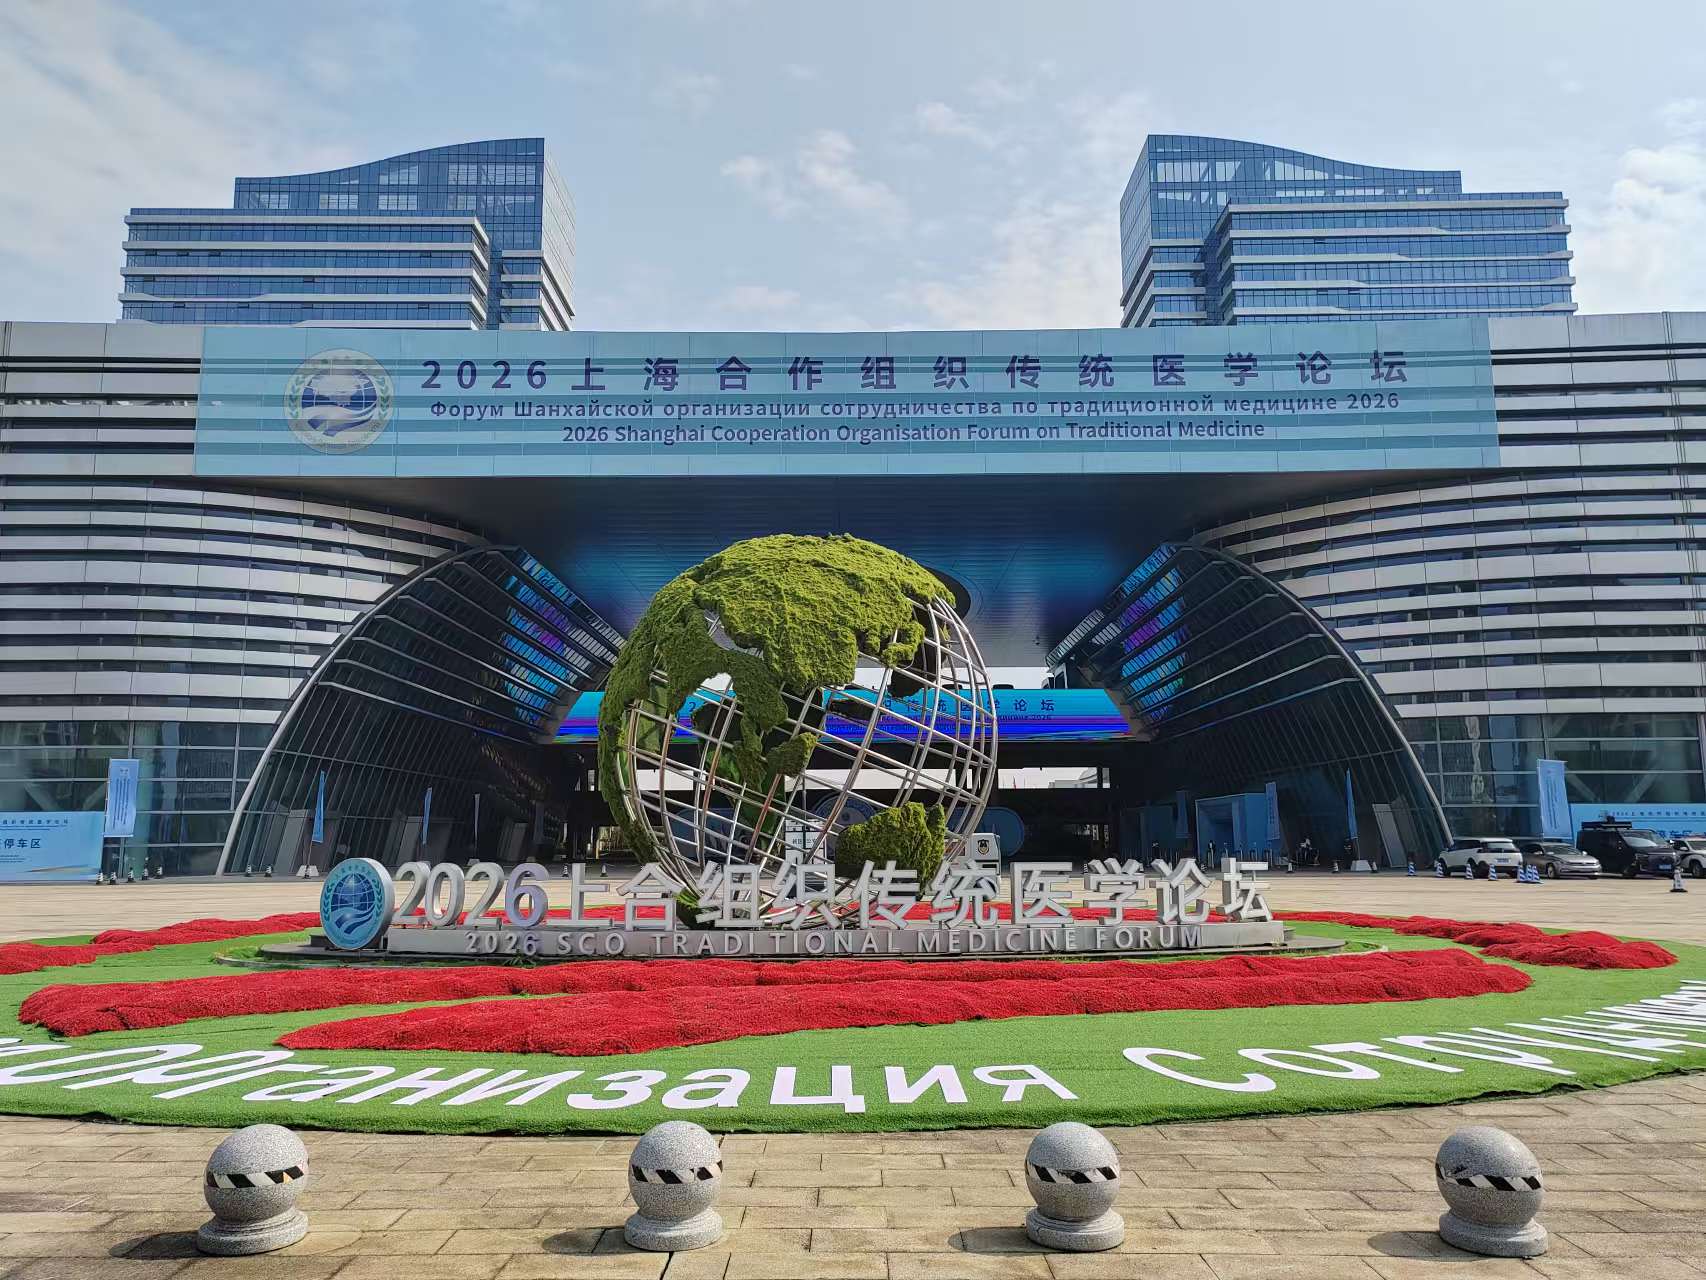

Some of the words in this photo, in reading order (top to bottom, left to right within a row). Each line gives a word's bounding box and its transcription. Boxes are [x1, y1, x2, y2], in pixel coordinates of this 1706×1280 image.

[421, 350, 1407, 391] 2026上海合作组织传统医学论坛
[430, 401, 504, 420] Форум
[514, 400, 653, 417] Шанхайской
[663, 402, 810, 419] организации
[820, 401, 1001, 419] сотрудничества
[1012, 401, 1038, 414] по
[1048, 394, 1214, 416] традиционной
[1224, 398, 1337, 414] медицине
[1347, 393, 1400, 409] 2026
[562, 425, 608, 442] 2026
[615, 424, 705, 445] Shanghai
[711, 424, 830, 445] Cooperation
[836, 424, 961, 445] Organisation
[967, 423, 1030, 441] Forum
[1037, 427, 1060, 439] on
[1066, 421, 1173, 439] Traditional
[1178, 420, 1265, 438] Medicine
[0, 837, 41, 849] 停车区
[393, 857, 1273, 931] 2026上合组织传统医学论坛
[465, 931, 541, 957] 2026
[558, 933, 626, 956] SCO
[653, 929, 900, 956] TRADITIONAL
[917, 928, 1078, 953] MEDICINE
[1096, 925, 1202, 950] FORUM
